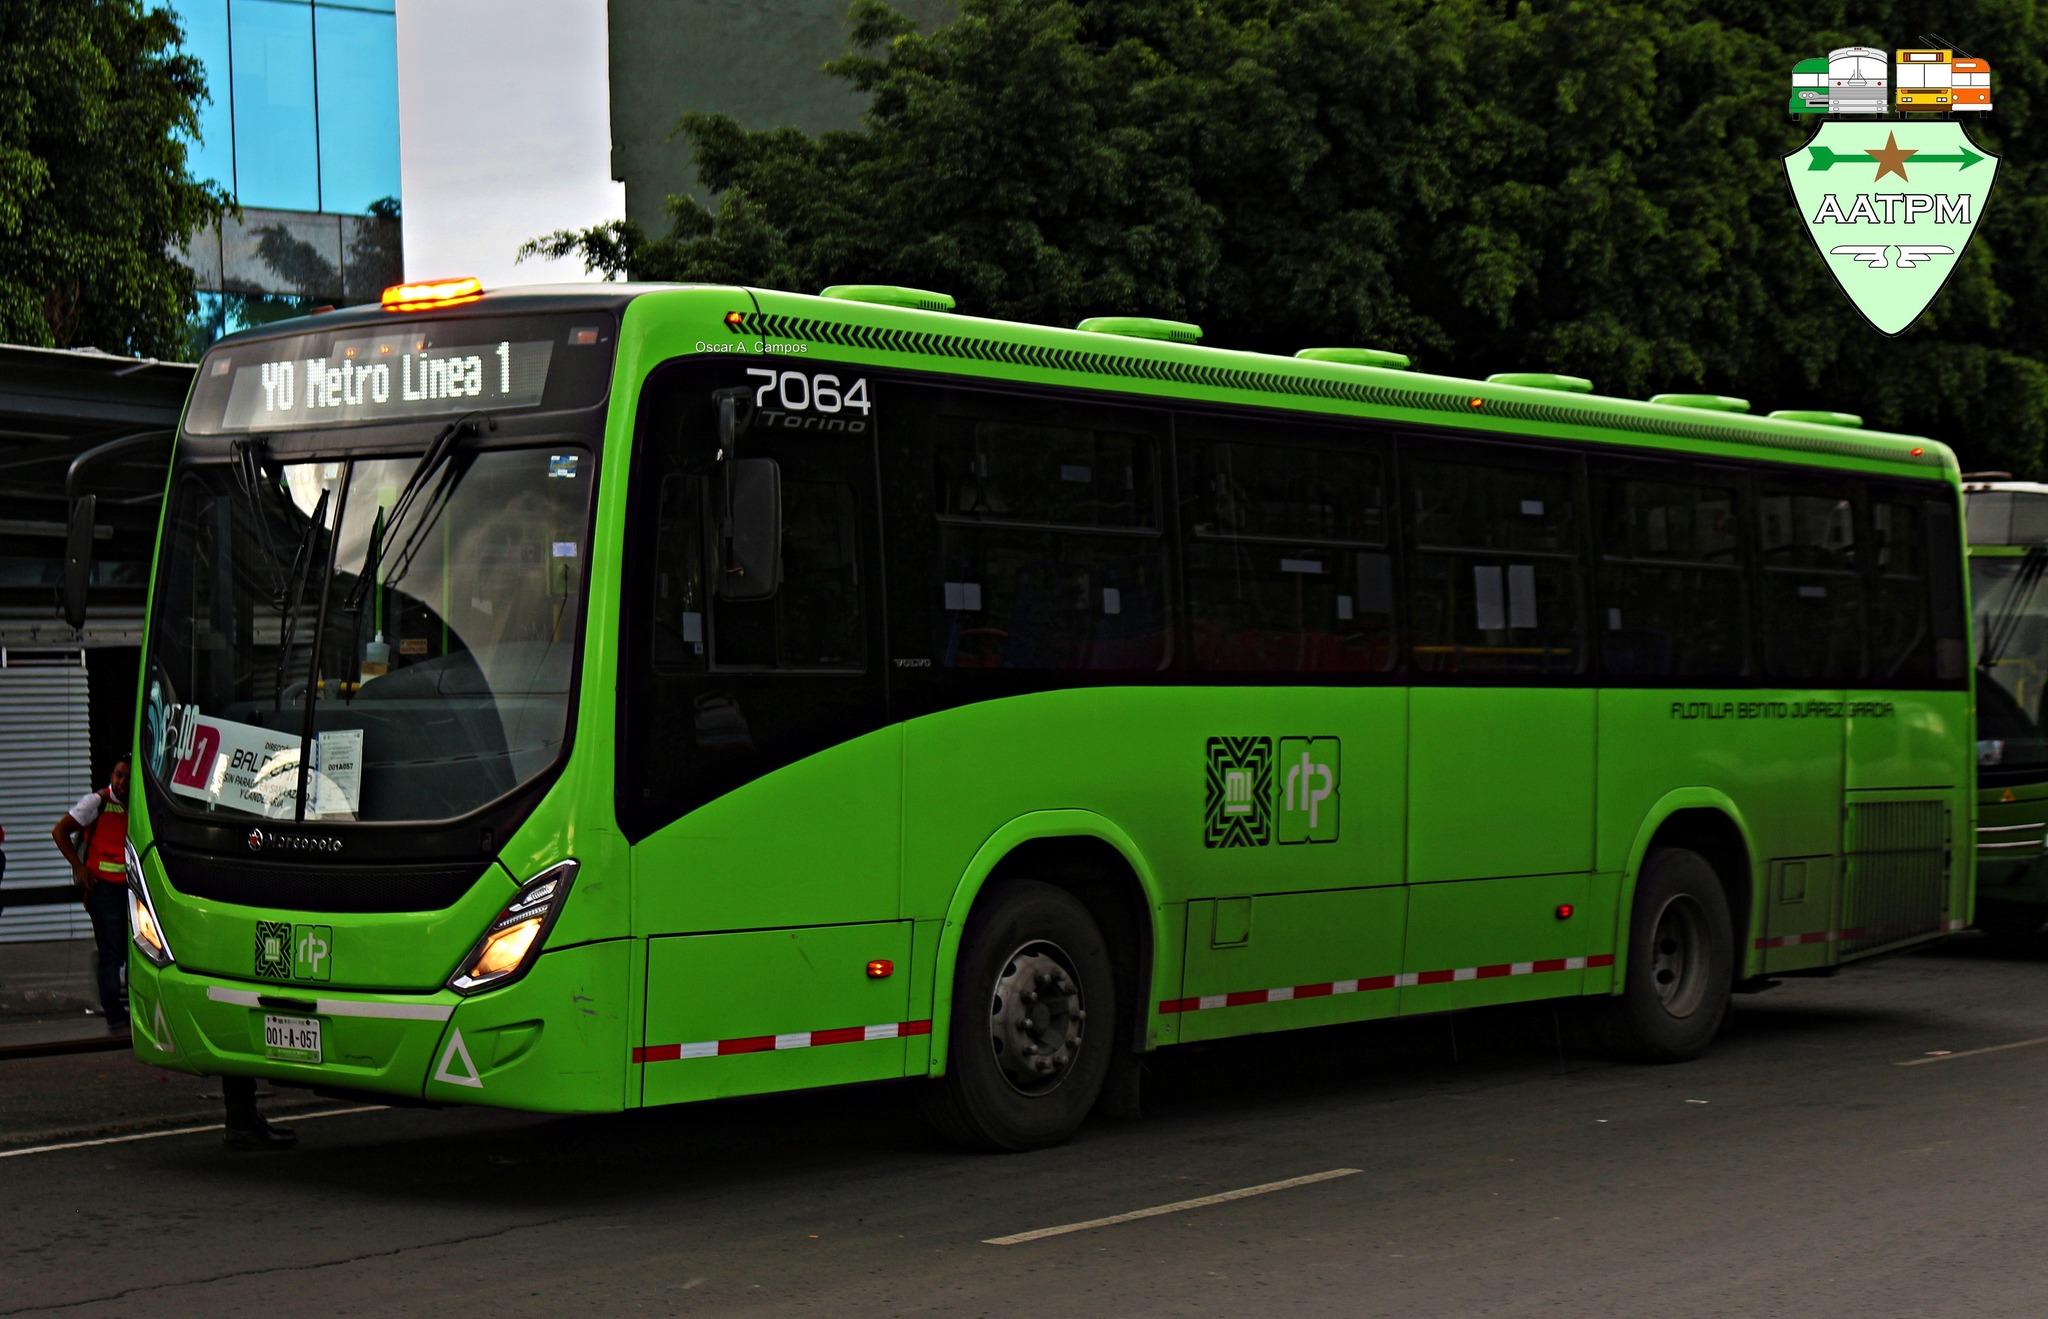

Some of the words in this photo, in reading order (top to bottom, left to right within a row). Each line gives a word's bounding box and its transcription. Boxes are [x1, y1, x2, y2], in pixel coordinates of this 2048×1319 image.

[307, 358, 390, 408] Metro
[403, 352, 482, 401] Linea
[496, 341, 510, 393] 1
[746, 367, 871, 416] 7064
[761, 410, 866, 433] Torino
[894, 658, 931, 668] VOLVO
[1671, 702, 1734, 719] FLOTILLA
[1739, 702, 1787, 719] BENITO
[193, 737, 208, 777] 1
[327, 762, 354, 771] 001A057
[245, 791, 284, 808] CANDEARIA
[266, 832, 343, 853] Marcopolo
[266, 1027, 318, 1049] 001-A-057
